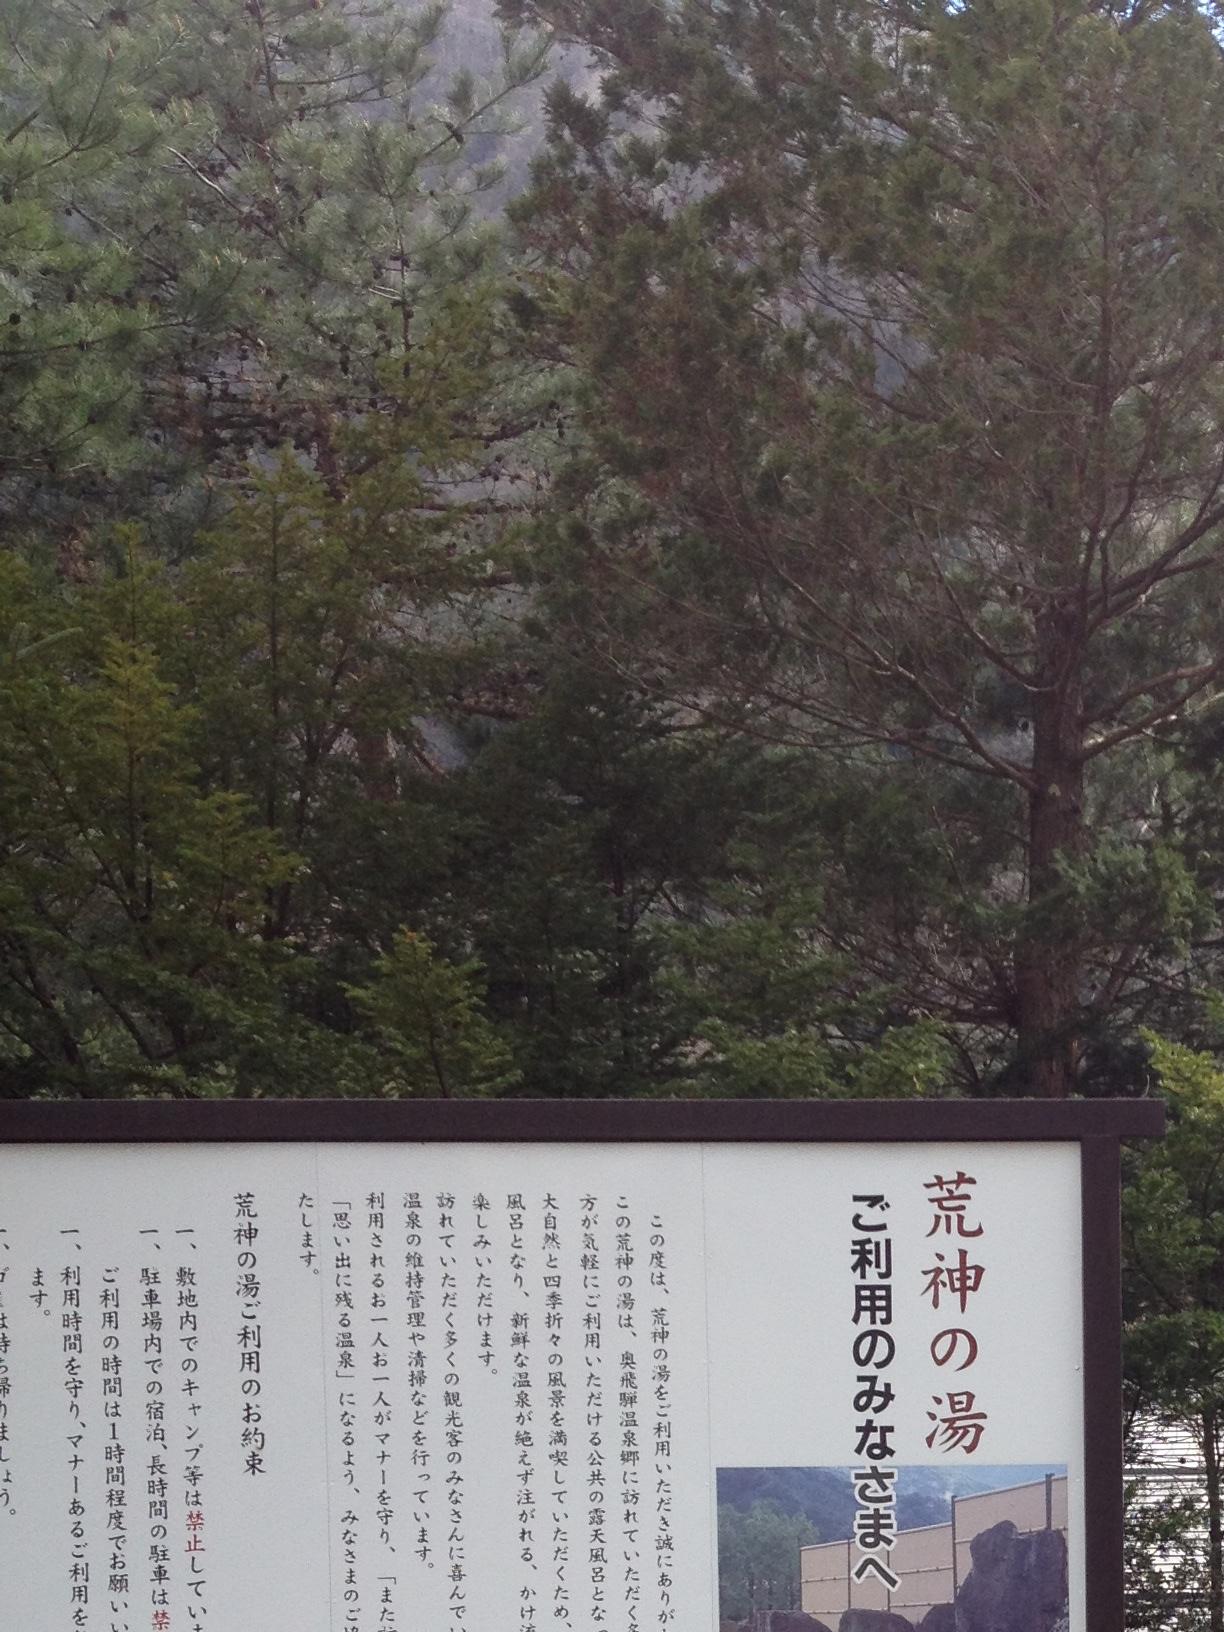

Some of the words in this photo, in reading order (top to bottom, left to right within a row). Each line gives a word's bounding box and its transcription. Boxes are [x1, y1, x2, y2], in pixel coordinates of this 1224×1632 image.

[28, 1266, 51, 1317] ます。
[232, 1191, 267, 1477] 荒神の湯ご利用のお約束
[298, 1192, 320, 1275] たします。
[471, 1192, 498, 1375] 楽しみいただけます。
[920, 1170, 988, 1455] 荒神の湯
[402, 1191, 435, 1569] 温泉の維持管理や清掃などを行っています。
[849, 1191, 900, 1591] ご利用のみなさまへ
